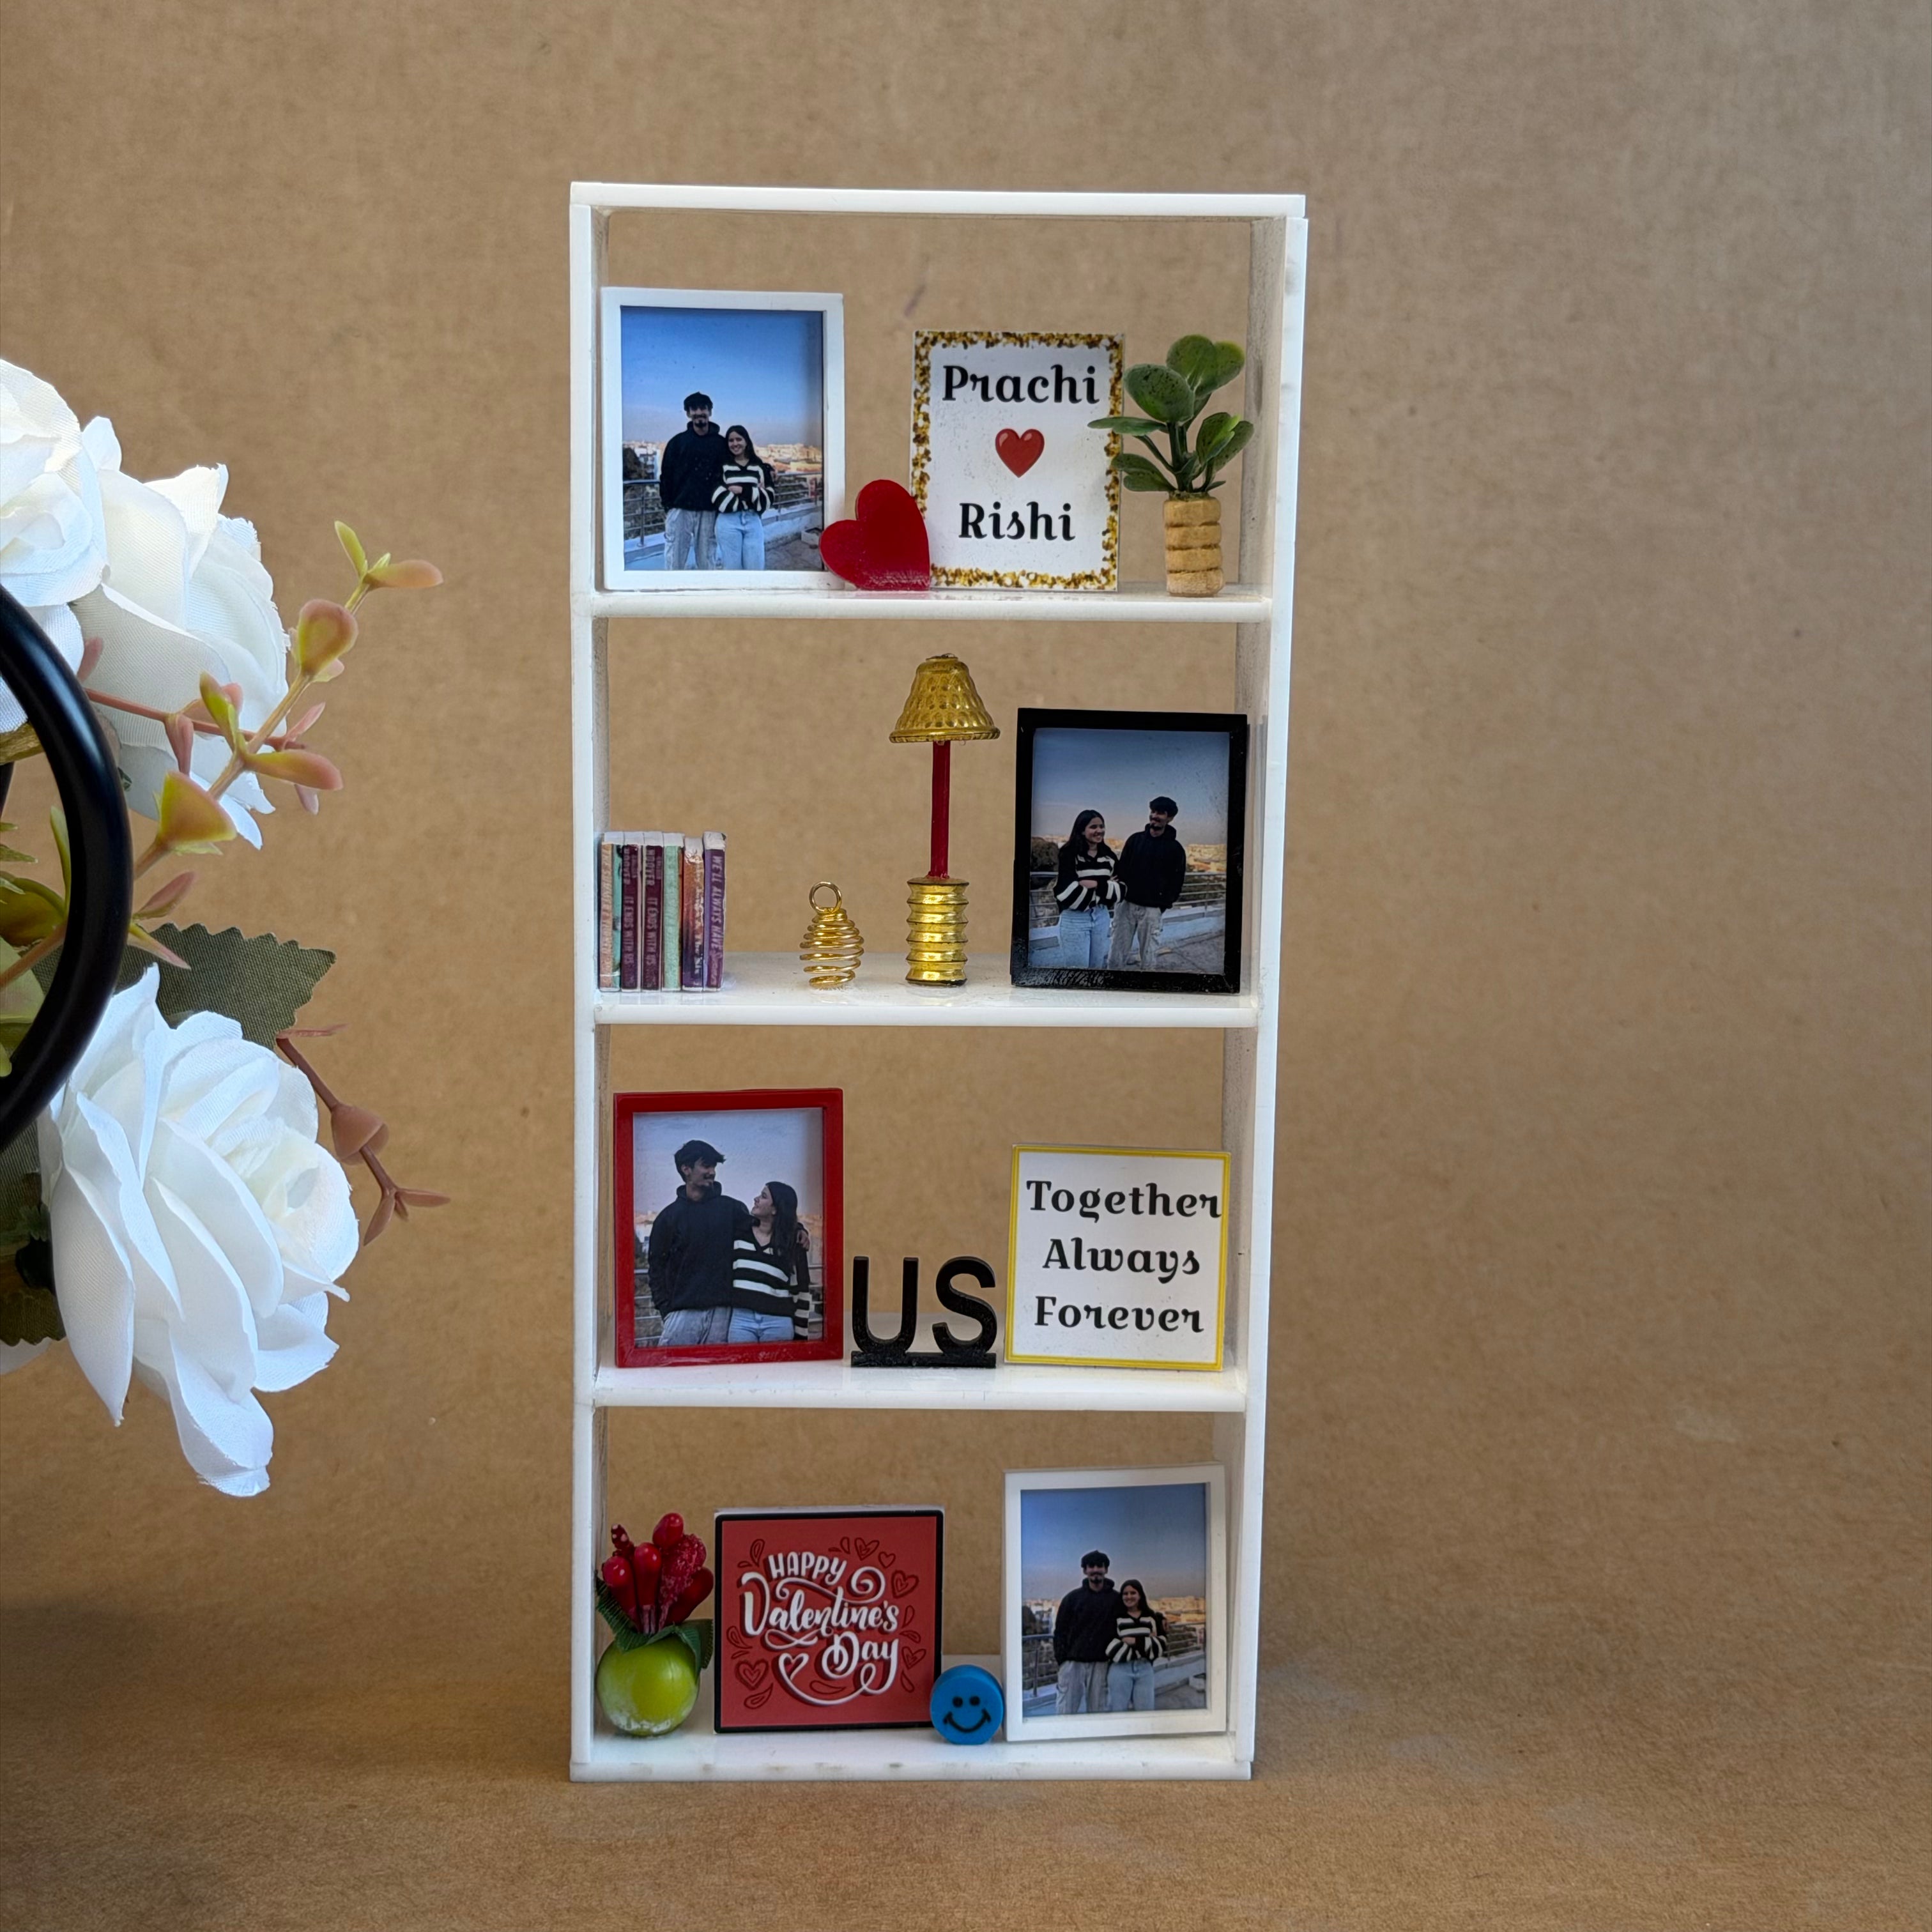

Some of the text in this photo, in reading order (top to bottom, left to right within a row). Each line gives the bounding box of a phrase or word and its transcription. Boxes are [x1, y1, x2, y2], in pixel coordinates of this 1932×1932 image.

[942, 364, 1100, 404] Prachi
[958, 501, 1076, 541] Rishi
[710, 884, 723, 923] ALWAYS
[710, 924, 723, 950] HAVE
[1026, 1180, 1222, 1223] Together
[1042, 1237, 1200, 1284] Always
[852, 1256, 998, 1355] US
[1034, 1296, 1205, 1333] Forever
[741, 1572, 900, 1636] Valentine's
[822, 1630, 900, 1694] Day
